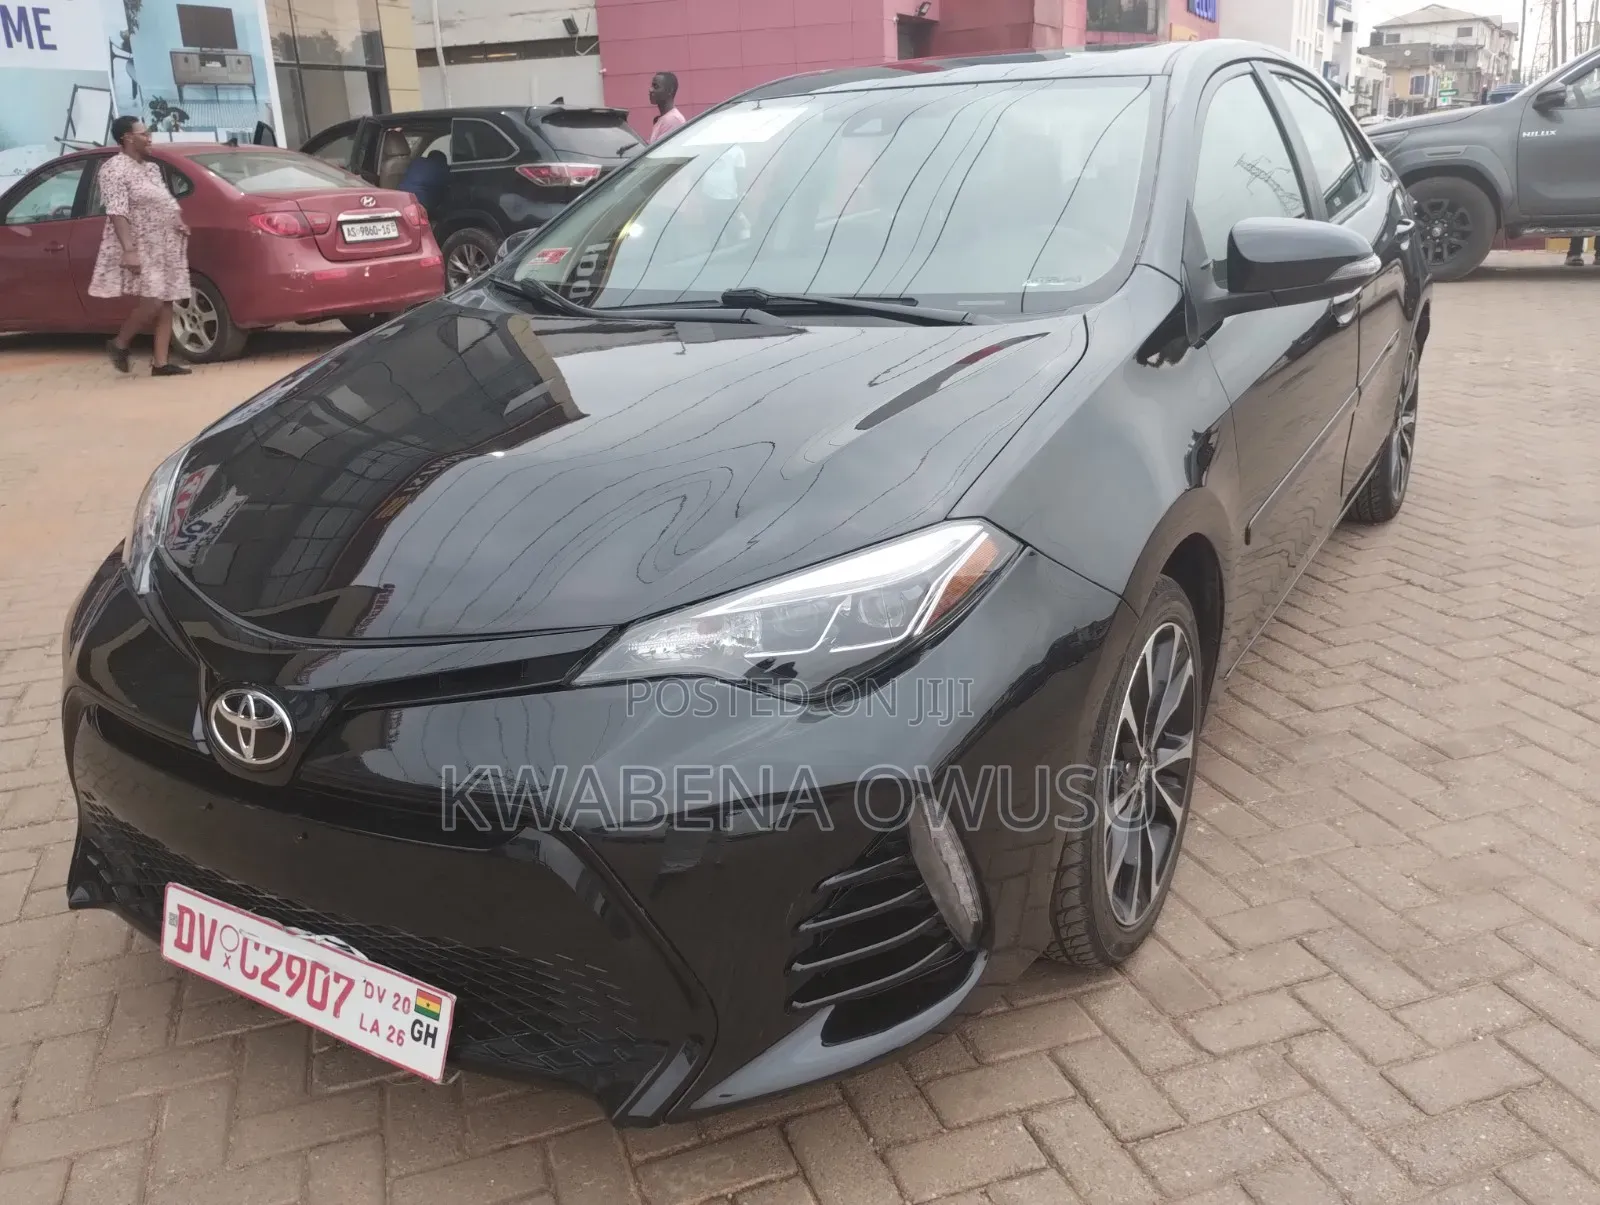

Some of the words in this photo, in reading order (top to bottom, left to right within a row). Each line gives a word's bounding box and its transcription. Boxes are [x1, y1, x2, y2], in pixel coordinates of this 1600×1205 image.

[0, 5, 58, 50] ME
[174, 903, 218, 961] DV
[240, 937, 355, 1019] C2907
[364, 981, 386, 1004] DV
[392, 992, 411, 1015] 20
[360, 1013, 380, 1037] LA
[386, 1024, 406, 1047] 26
[410, 1018, 438, 1049] GH
